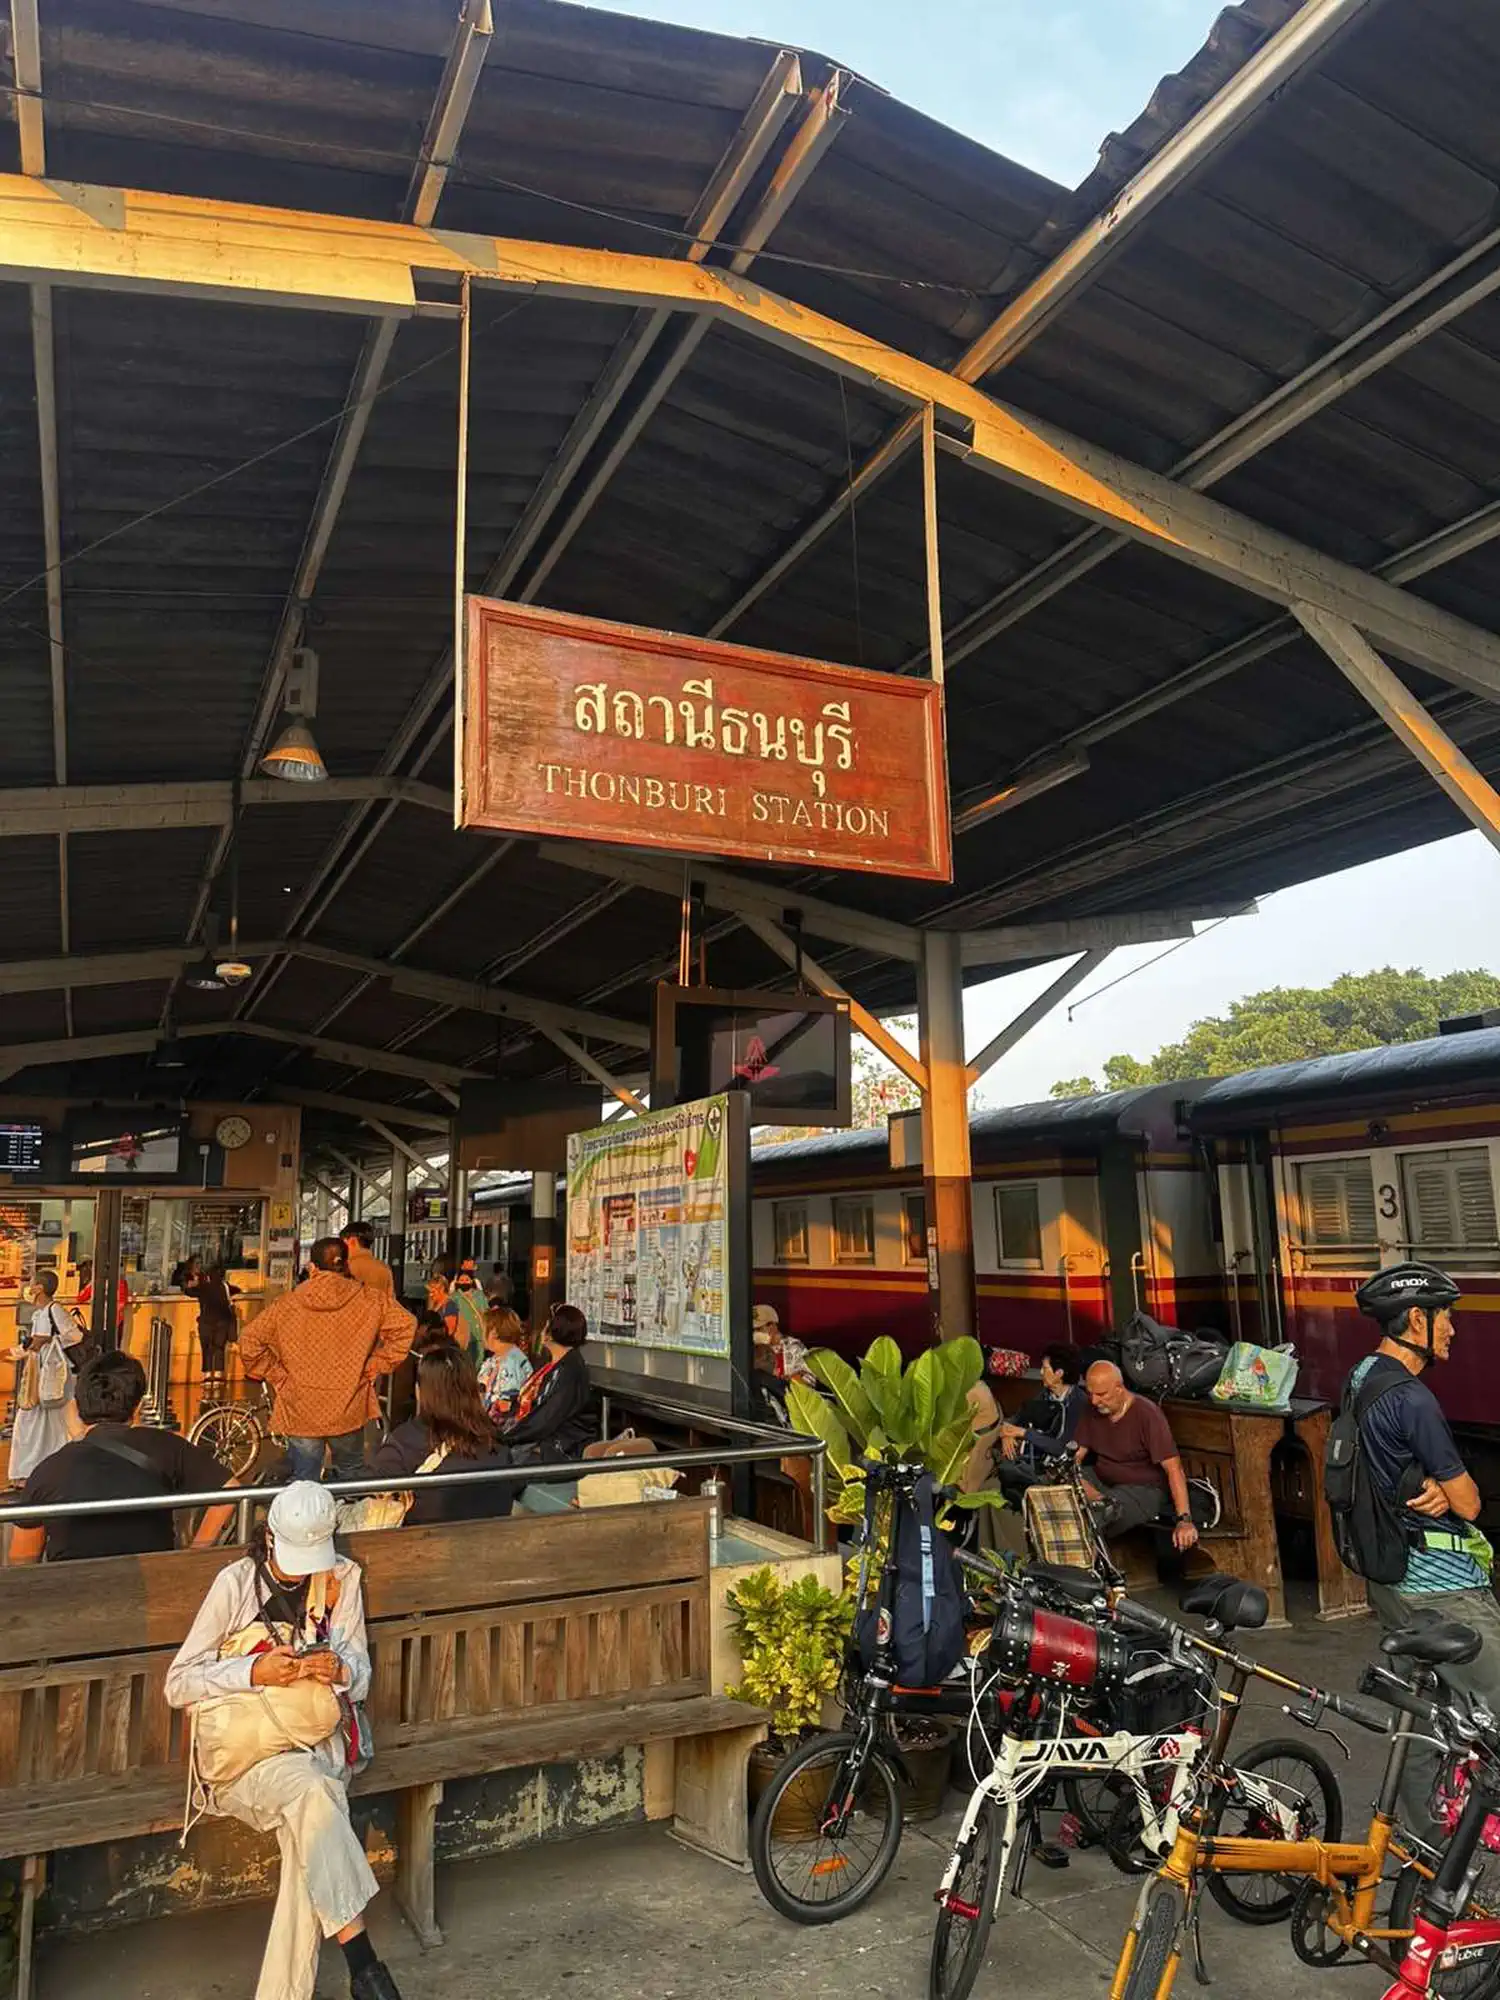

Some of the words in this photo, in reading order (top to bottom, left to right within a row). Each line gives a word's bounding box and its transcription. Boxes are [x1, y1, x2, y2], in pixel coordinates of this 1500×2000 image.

[575, 678, 853, 797] สถานีธนบุรี
[537, 763, 728, 817] THONBURI
[751, 792, 890, 837] STATION
[1379, 1184, 1398, 1219] 3
[1019, 1742, 1110, 1763] JAVA
